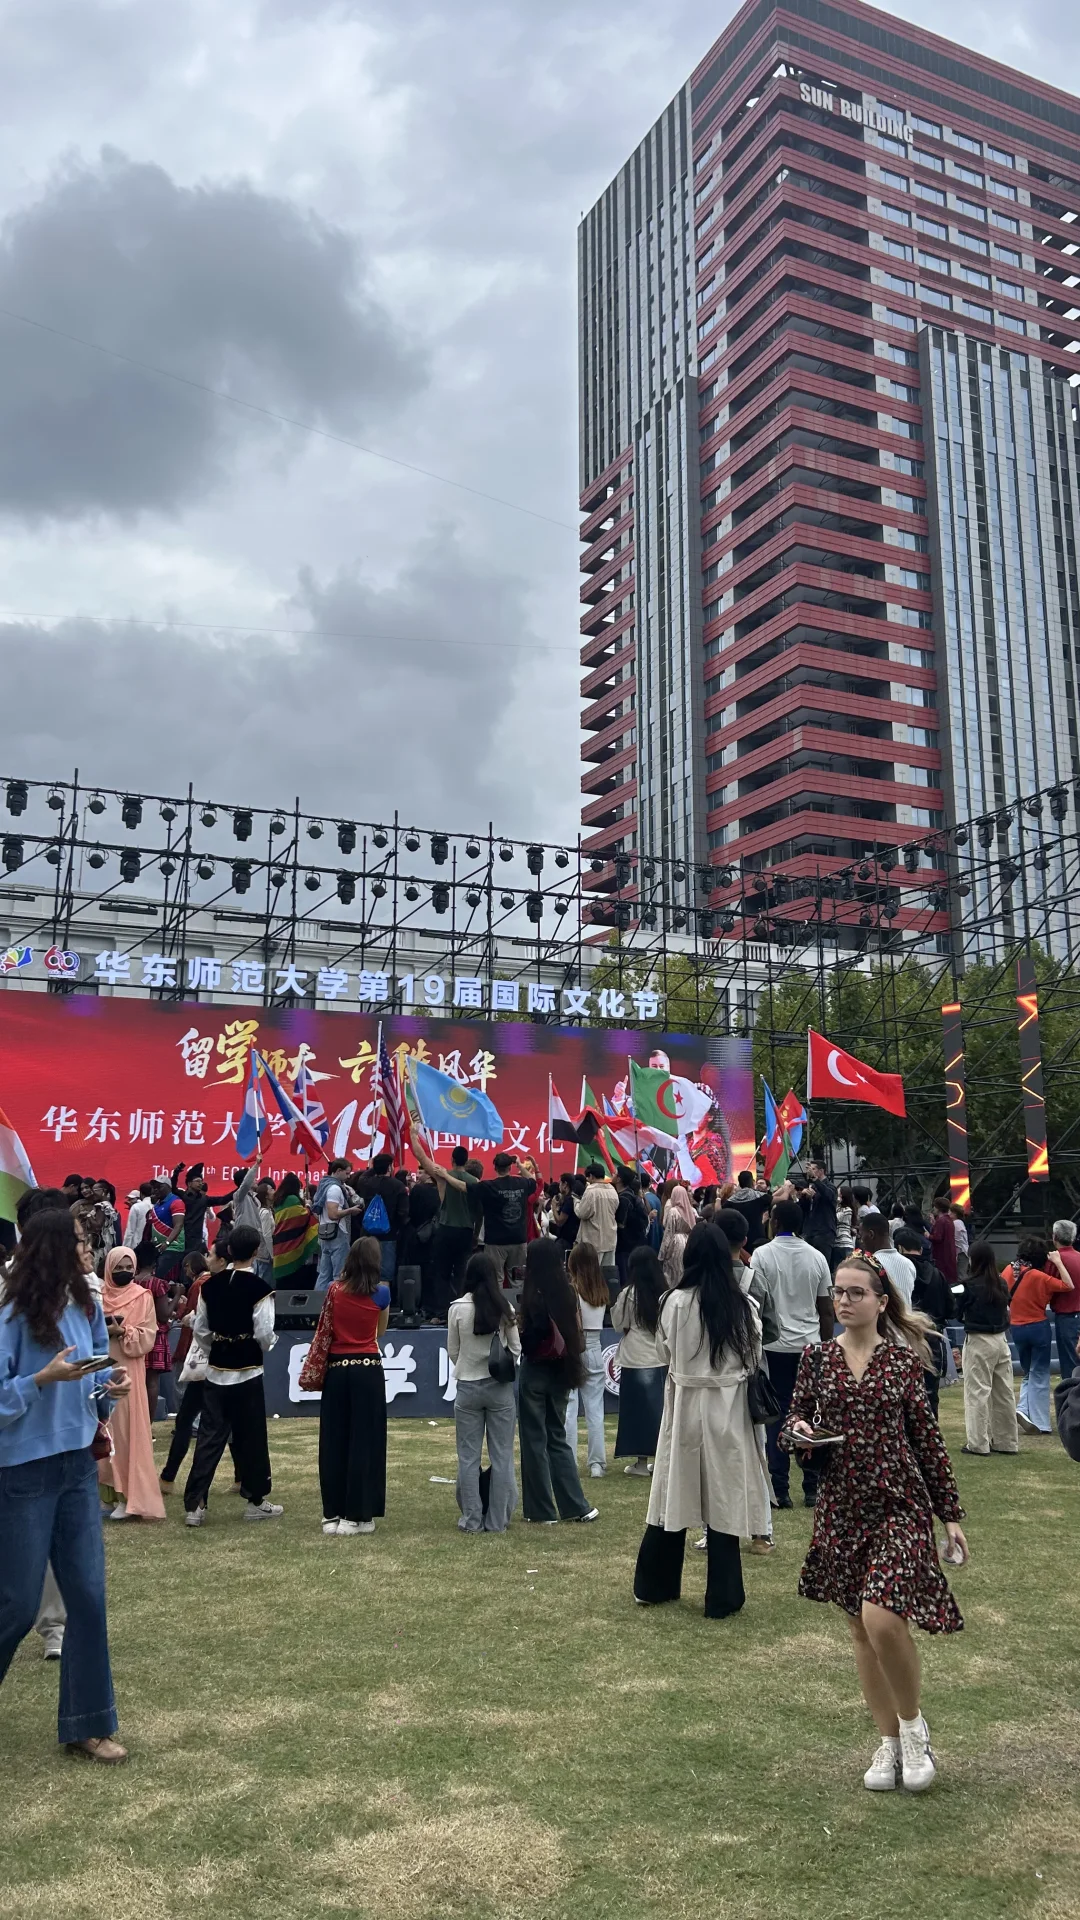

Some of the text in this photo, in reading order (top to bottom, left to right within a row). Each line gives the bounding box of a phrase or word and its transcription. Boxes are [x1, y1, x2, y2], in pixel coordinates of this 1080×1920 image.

[799, 82, 914, 144] SUN BUILDING
[94, 949, 660, 1021] 华东师范大学第19届国际文化节
